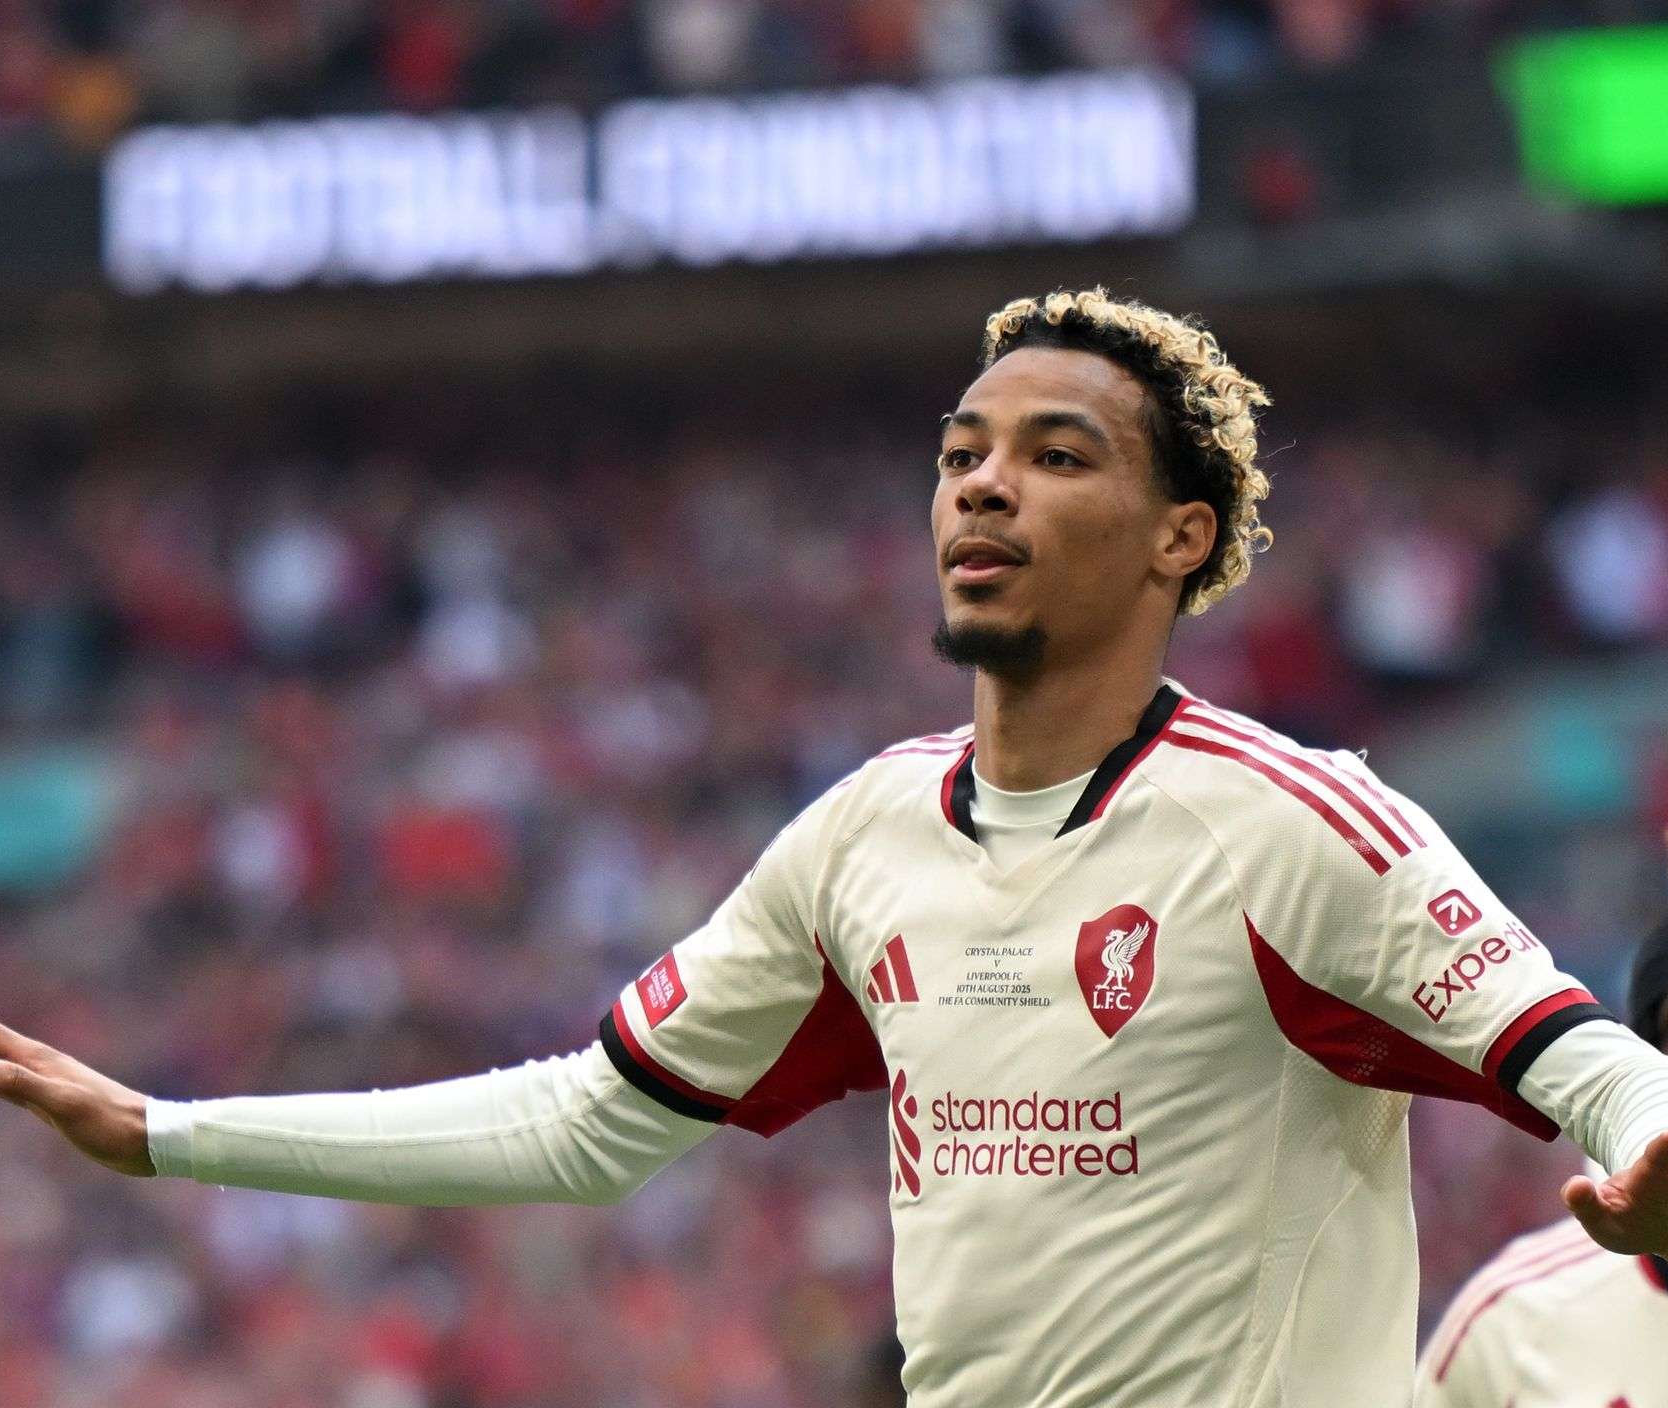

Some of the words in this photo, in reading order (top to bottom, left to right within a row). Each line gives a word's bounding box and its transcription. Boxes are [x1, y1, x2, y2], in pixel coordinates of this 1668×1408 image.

[965, 947, 1000, 956] CRYSTAL
[1001, 947, 1034, 956] PALACE
[966, 971, 1012, 981] LIVERPOOL
[1012, 971, 1023, 981] FC
[956, 984, 977, 993] 10TH
[977, 984, 1010, 993] AUGUST
[1011, 984, 1031, 994] 2025
[938, 996, 954, 1006] THE
[954, 996, 964, 1006] FA
[964, 997, 1019, 1007] COMMUNITY
[1020, 997, 1051, 1007] SHIELD
[932, 1090, 1123, 1132] standard
[933, 1135, 1139, 1177] chartered
